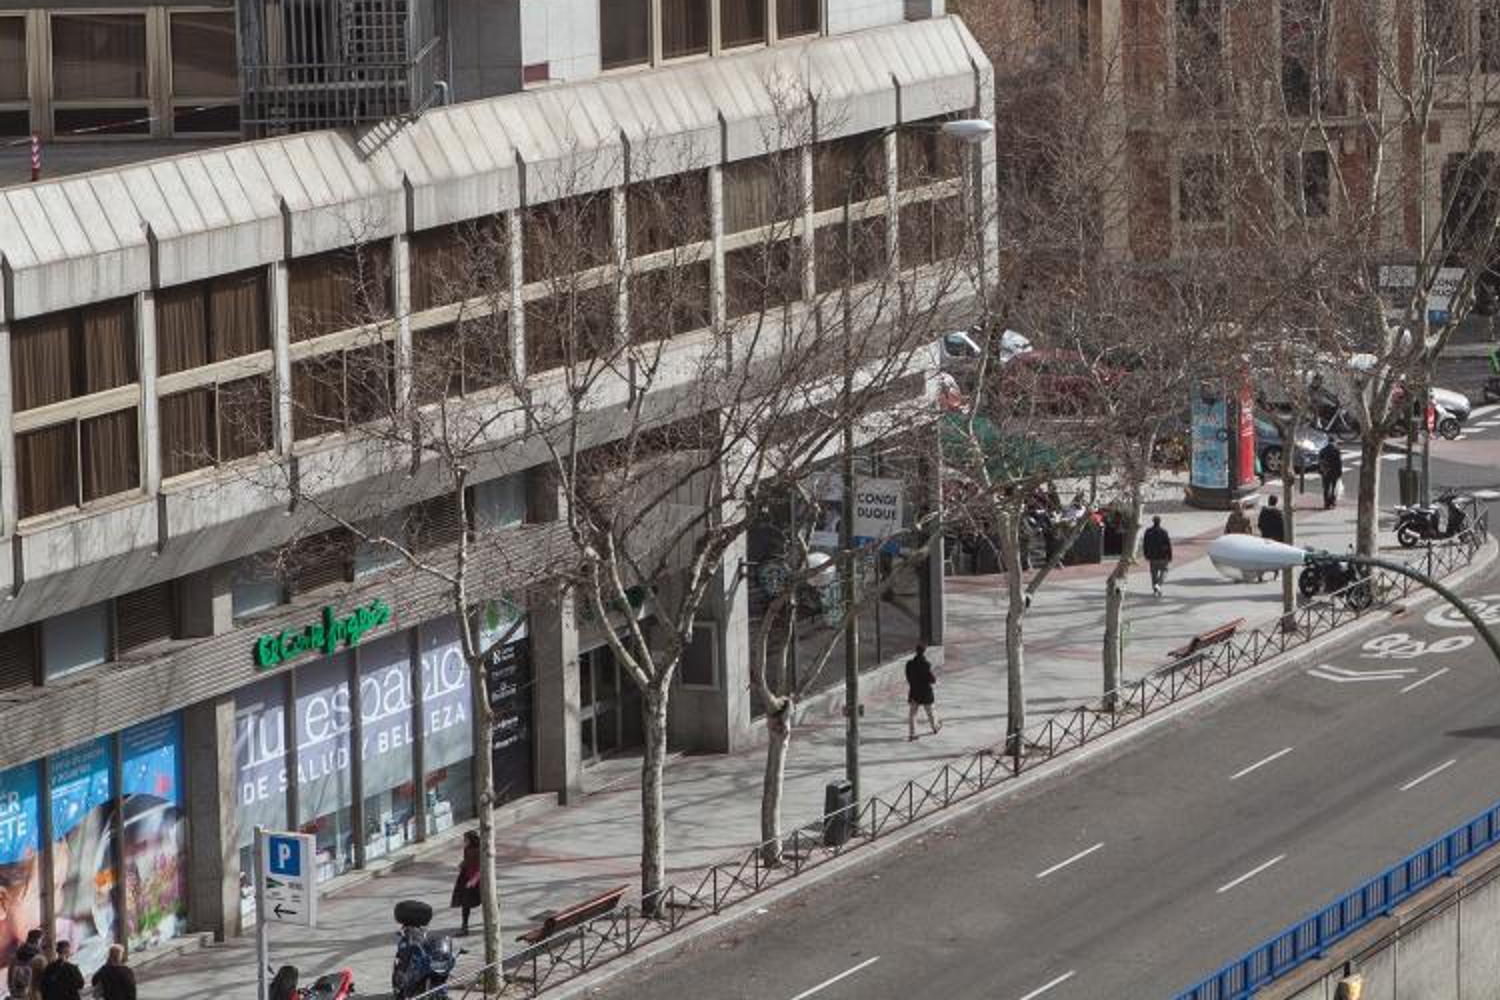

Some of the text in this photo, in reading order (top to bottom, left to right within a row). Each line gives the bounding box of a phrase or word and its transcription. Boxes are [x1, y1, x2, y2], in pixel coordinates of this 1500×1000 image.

[235, 703, 285, 767] Tu
[243, 776, 269, 806] DE
[377, 702, 466, 754] BELEZA
[278, 843, 291, 869] P
